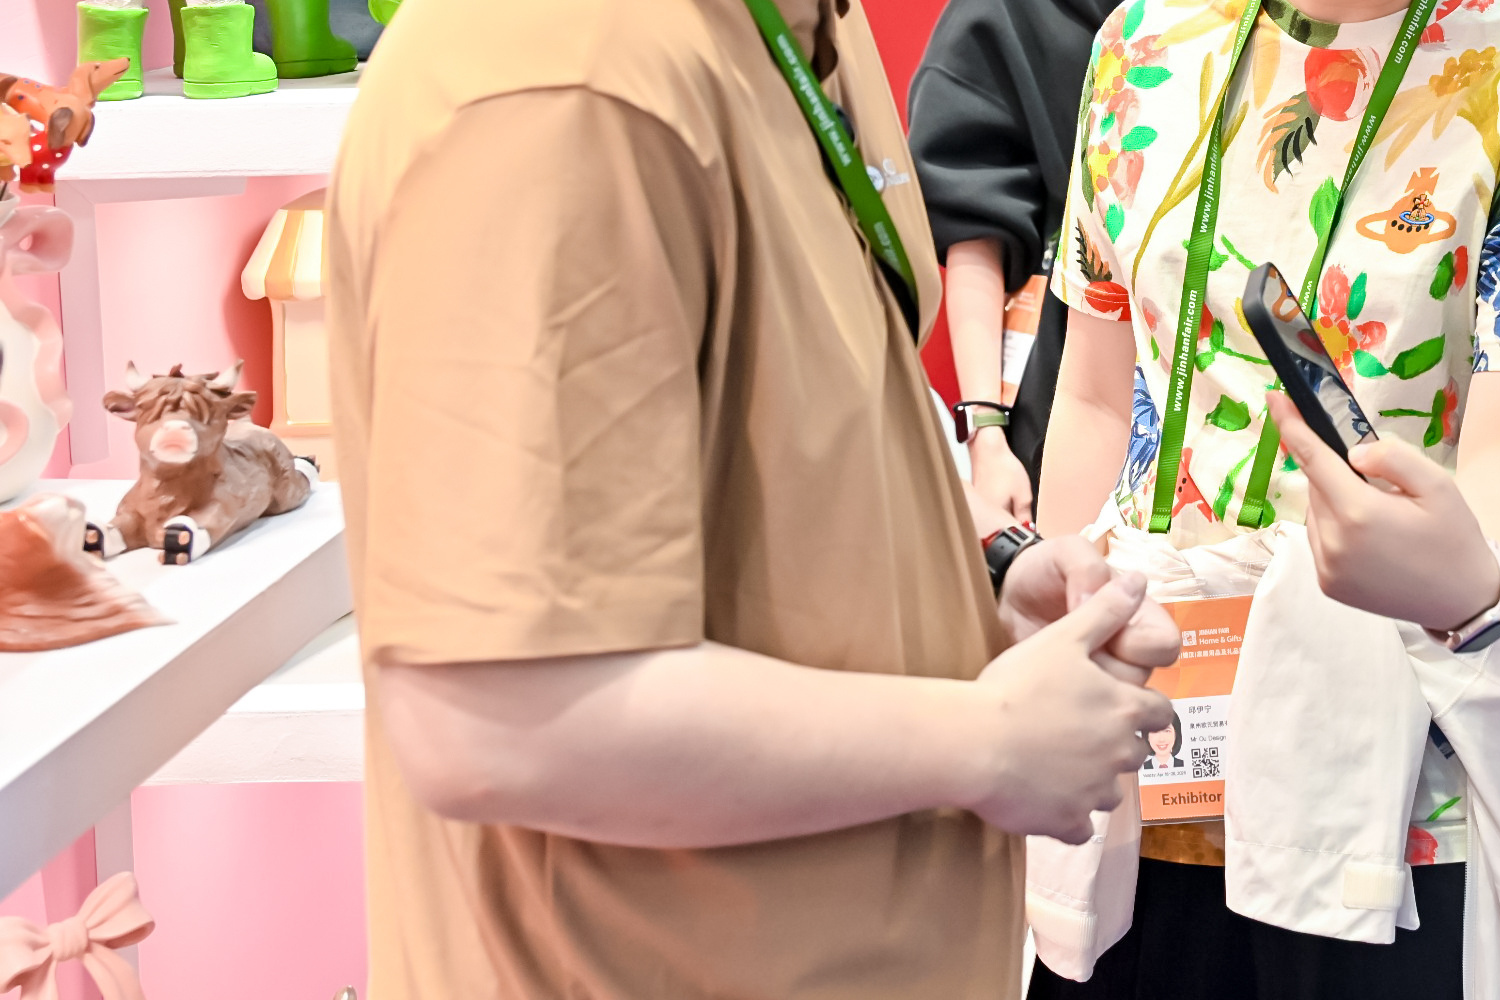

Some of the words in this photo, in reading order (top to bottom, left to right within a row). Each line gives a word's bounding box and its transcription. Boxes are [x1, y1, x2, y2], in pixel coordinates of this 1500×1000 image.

[1200, 119, 1221, 233] www.jinhanfair.com
[1174, 289, 1198, 412] www.jinhanfair.com
[1199, 637, 1219, 645] Home
[1226, 634, 1242, 643] Gifts
[1161, 791, 1222, 806] Exhibitor
